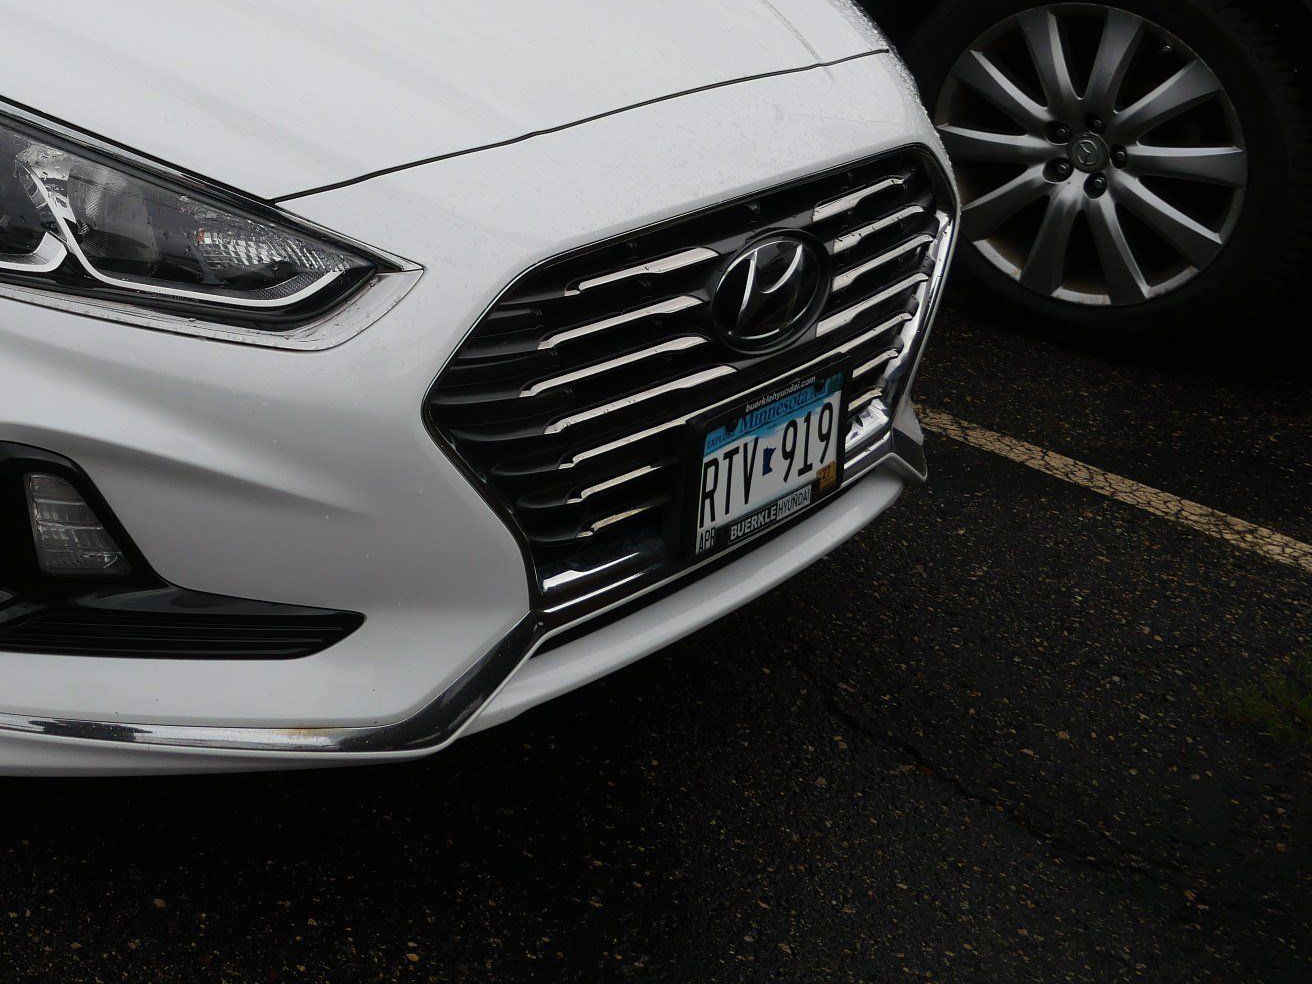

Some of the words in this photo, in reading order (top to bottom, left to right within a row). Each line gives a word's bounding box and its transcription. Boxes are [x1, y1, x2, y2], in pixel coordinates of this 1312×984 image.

[698, 436, 759, 529] RTV
[782, 402, 833, 483] 919
[699, 527, 716, 552] APR
[730, 506, 778, 540] BUERKLE
[778, 488, 811, 517] HYUNDAI
